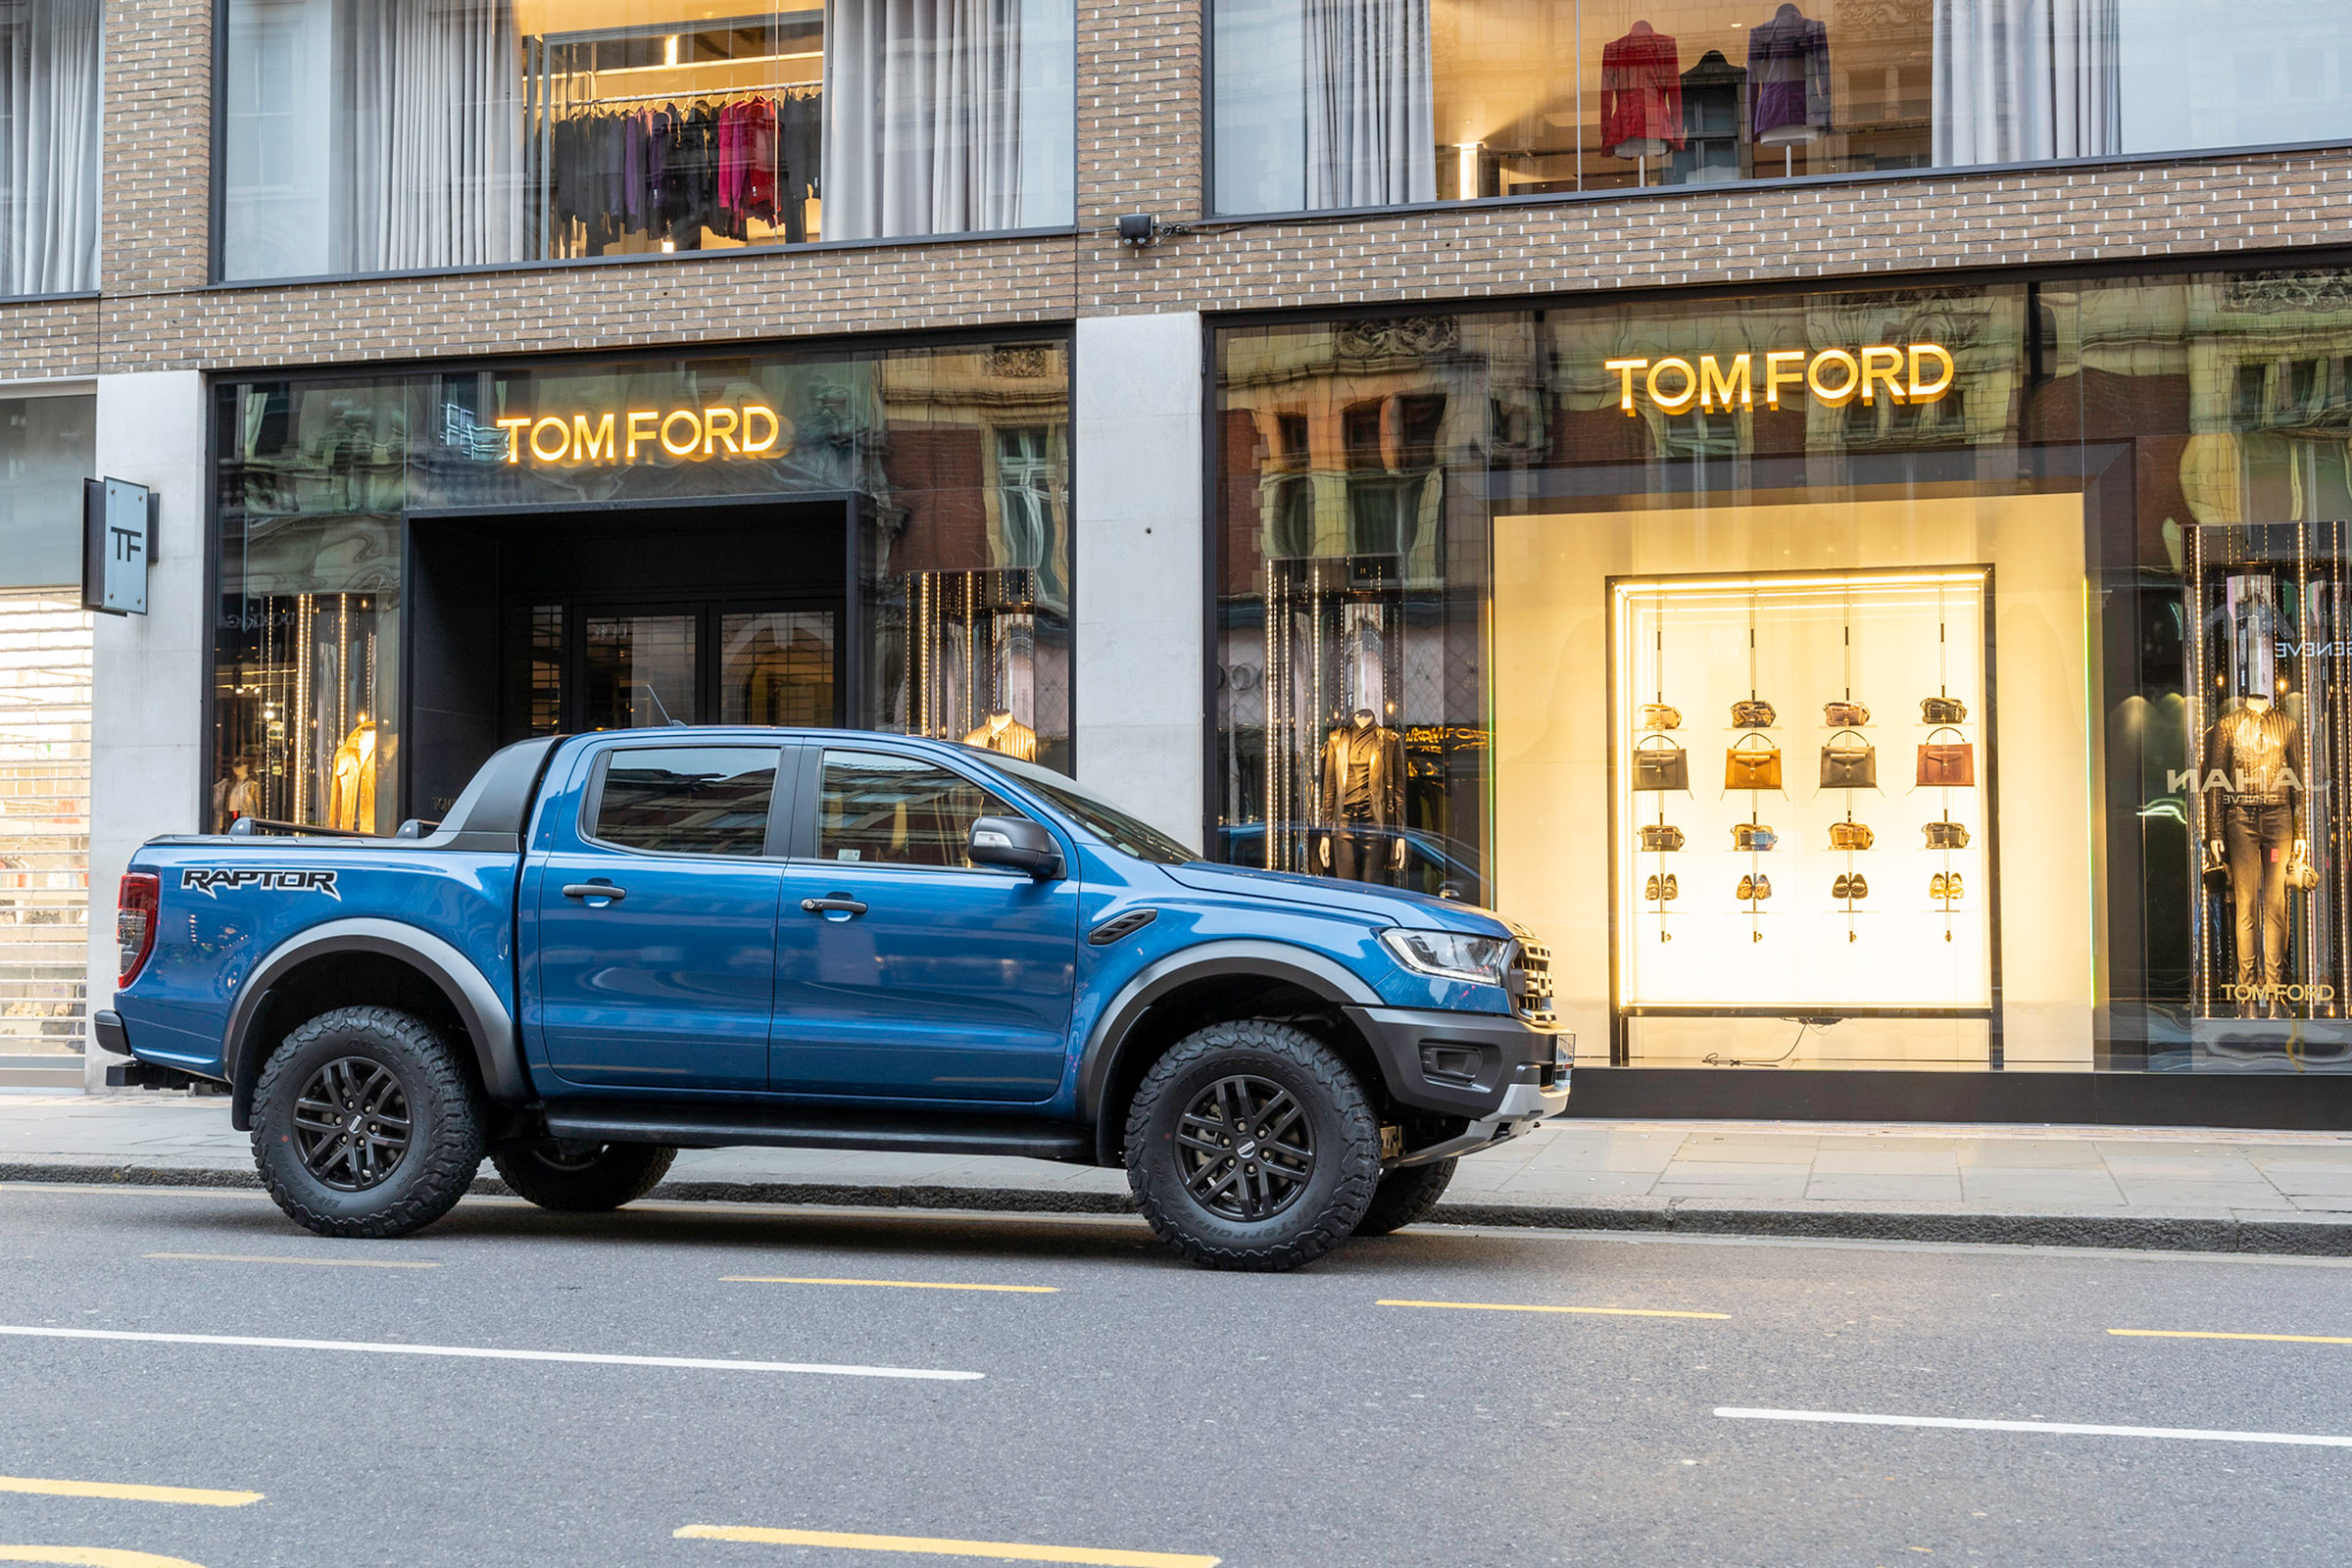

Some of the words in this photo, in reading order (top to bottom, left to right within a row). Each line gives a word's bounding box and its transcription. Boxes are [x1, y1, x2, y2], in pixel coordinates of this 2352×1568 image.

[1604, 354, 1751, 411] TOM
[1765, 344, 1954, 404] FORD
[496, 413, 614, 464] TOM
[626, 406, 779, 458] FORD
[111, 526, 142, 562] TF
[181, 868, 342, 902] RAPTOR
[2221, 984, 2270, 1001] TOM
[2274, 984, 2335, 1001] FORD
